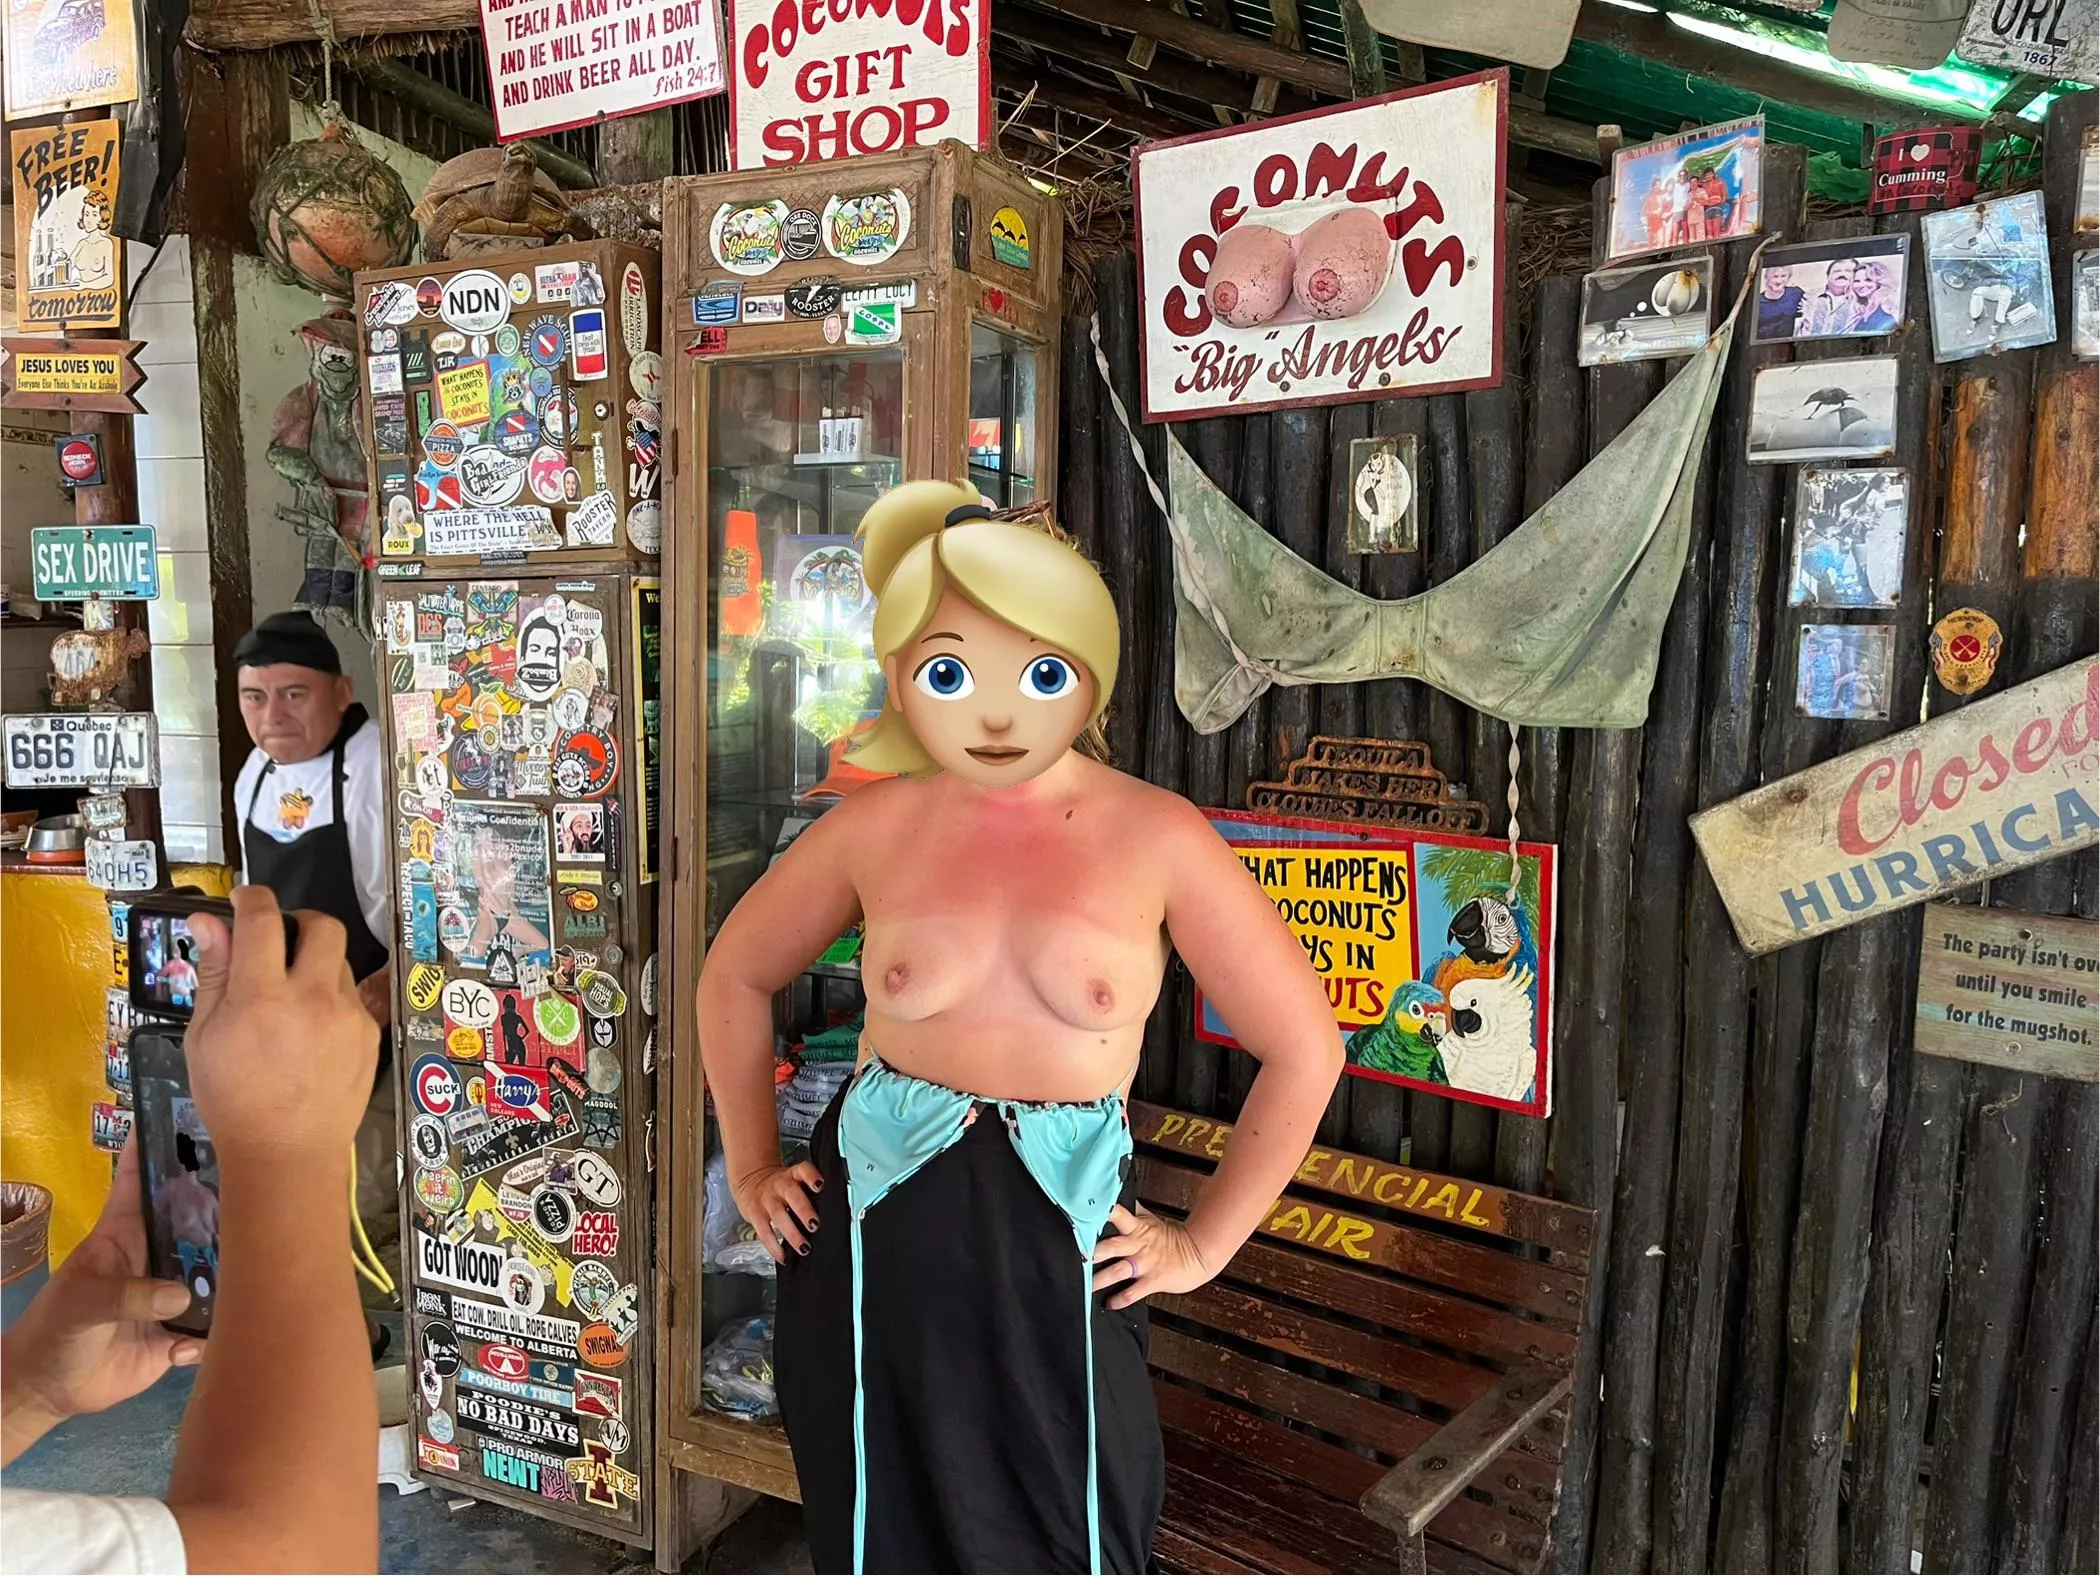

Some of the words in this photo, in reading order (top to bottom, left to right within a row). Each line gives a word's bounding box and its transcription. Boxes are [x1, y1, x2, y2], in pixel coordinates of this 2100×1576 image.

[505, 9, 550, 41] TEACH
[555, 3, 567, 28] A
[571, 0, 608, 24] MAN
[500, 49, 525, 76] AND
[530, 43, 546, 68] HE
[551, 32, 585, 63] WILL
[591, 22, 619, 53] SIT
[625, 16, 641, 44] IN
[646, 12, 656, 38] A
[663, 1, 701, 35] BOAT
[503, 81, 528, 108] AND
[533, 69, 574, 101] DRINK
[580, 58, 621, 90] BEER
[628, 50, 656, 78] ALL
[662, 37, 701, 70] DAY.
[794, 43, 912, 104] GIFT
[761, 97, 950, 168] SHOP
[17, 127, 91, 190] FREE
[33, 139, 116, 220] BEER!
[1878, 166, 1947, 190] Cumming
[1163, 141, 1465, 338] COCONUTS
[27, 290, 118, 315] tomorrow
[448, 287, 500, 316] NDN
[791, 294, 835, 313] ROOSTER
[1267, 306, 1463, 390] Angels
[21, 359, 52, 374] JESUS
[55, 359, 89, 374] LOVES
[92, 360, 115, 375] YOU
[441, 375, 458, 386] WHAT
[459, 367, 485, 381] HAPPENS
[18, 377, 41, 391] Everyone
[42, 378, 52, 389] Else
[54, 378, 70, 389] Thinks
[71, 378, 88, 389] You're
[89, 380, 98, 389] An
[445, 403, 490, 419] COCONUTS
[432, 442, 455, 453] PIZZA
[433, 514, 480, 528] WHERE
[482, 512, 511, 523] THE
[511, 509, 547, 523] HELL
[572, 491, 616, 543] ROOSTER
[387, 540, 410, 549] ROUX
[430, 531, 444, 543] IS
[447, 525, 527, 541] PITTSVILLE
[37, 542, 78, 584] SEX
[83, 541, 150, 584] DRIVE
[405, 563, 422, 576] LEAF
[566, 608, 600, 621] Corona
[11, 733, 75, 770] 666
[94, 732, 145, 770] QAJ
[604, 742, 614, 768] BOY
[1320, 745, 1420, 768] TEQUILA
[1837, 662, 2099, 857] Closed
[43, 775, 57, 783] Je
[1301, 769, 1380, 795] MAKES
[1387, 775, 1439, 798] HER
[1256, 791, 1359, 818] CLOTHES
[1362, 800, 1417, 826] FALL
[1304, 857, 1407, 906] HAPPENS
[1272, 897, 1397, 942] OCONUTS
[1346, 941, 1375, 971] IN
[1942, 933, 1974, 956] The
[1978, 938, 2027, 967] party
[2031, 945, 2069, 970] isn't
[449, 986, 491, 1018] BYC
[589, 987, 611, 1009] HOPS
[1955, 970, 1996, 995] until
[2001, 978, 2034, 1004] you
[2037, 983, 2088, 1009] smile
[1945, 1002, 1973, 1025] for
[1977, 1009, 2006, 1031] the
[2009, 1015, 2093, 1047] mugshot.
[427, 1084, 460, 1095] SUCK
[578, 1158, 615, 1198] GT
[500, 1198, 533, 1210] BRANDON
[545, 1194, 565, 1229] PIZZA
[575, 1211, 618, 1234] LOCAL
[424, 1238, 452, 1278] GOT
[573, 1234, 618, 1256] HERO!
[416, 1287, 442, 1303] IRON
[453, 1301, 466, 1320] EAT
[487, 1309, 508, 1330] DRILL
[526, 1317, 546, 1337] ROPE
[547, 1321, 577, 1344] CALVES
[454, 1323, 507, 1343] WELCOME
[508, 1335, 524, 1349] TO
[526, 1340, 578, 1360] ALBERTA
[467, 1371, 530, 1397] POORBOY
[530, 1386, 561, 1400] TIRE
[471, 1390, 562, 1420] POODIE'S
[456, 1396, 481, 1418] NO
[484, 1404, 523, 1430] BAD
[528, 1415, 579, 1446] DAYS
[488, 1439, 514, 1457] PRO
[516, 1447, 564, 1469] ARMOR
[501, 1433, 533, 1445] TEXAS
[481, 1447, 540, 1492] NEWT
[567, 1461, 638, 1499] STATE
